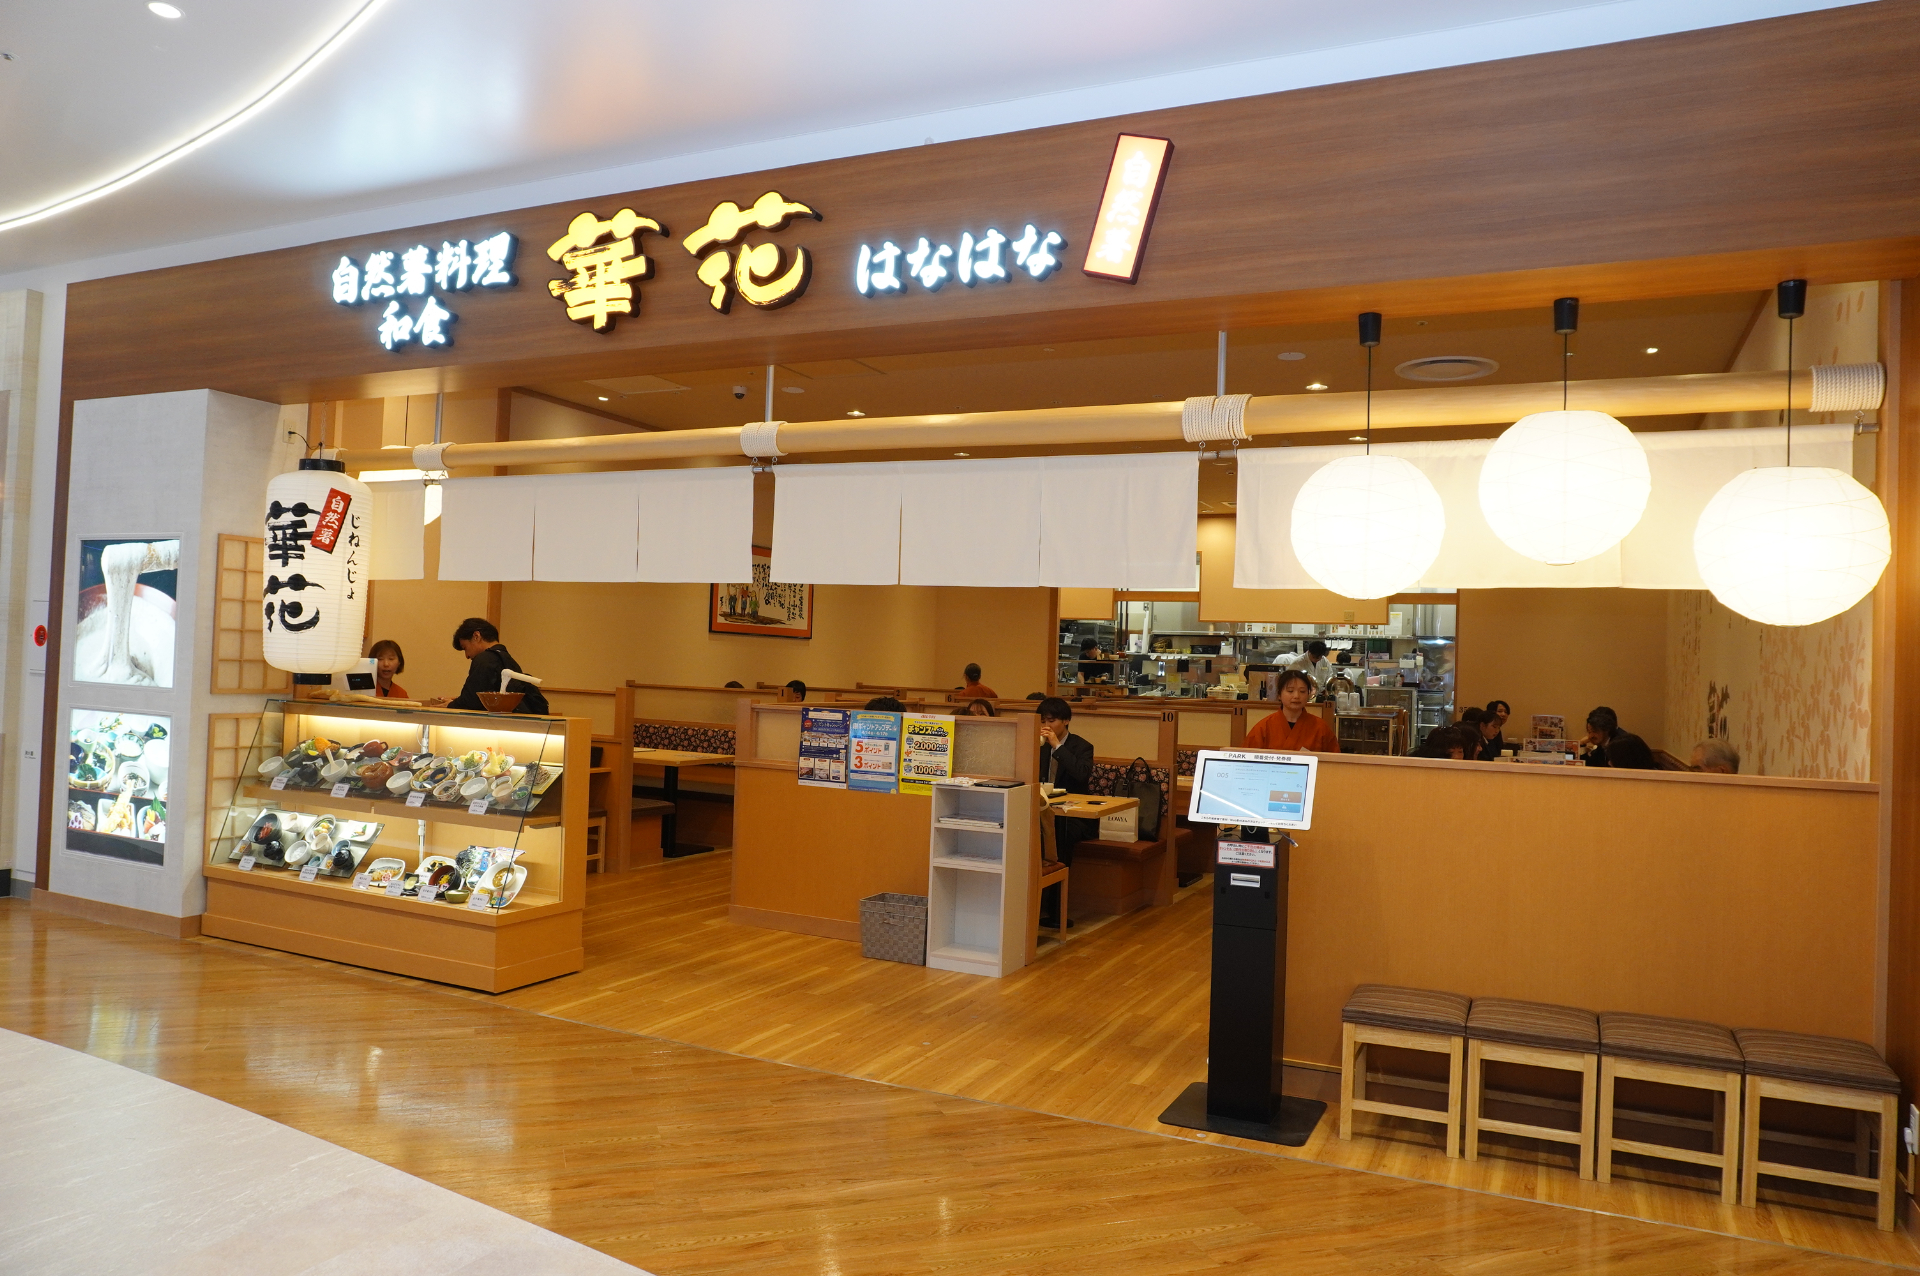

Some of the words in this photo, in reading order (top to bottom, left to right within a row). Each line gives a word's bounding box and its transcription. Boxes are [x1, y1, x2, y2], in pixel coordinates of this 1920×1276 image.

[332, 231, 511, 304] 自然薯料理
[547, 191, 814, 330] 華花
[856, 224, 1062, 294] はなはな
[378, 296, 450, 350] 和食
[316, 495, 345, 545] 自然薯
[263, 500, 326, 634] 華花
[346, 512, 361, 601] じねんじょ
[1162, 712, 1174, 722] 10
[1234, 707, 1243, 716] 11
